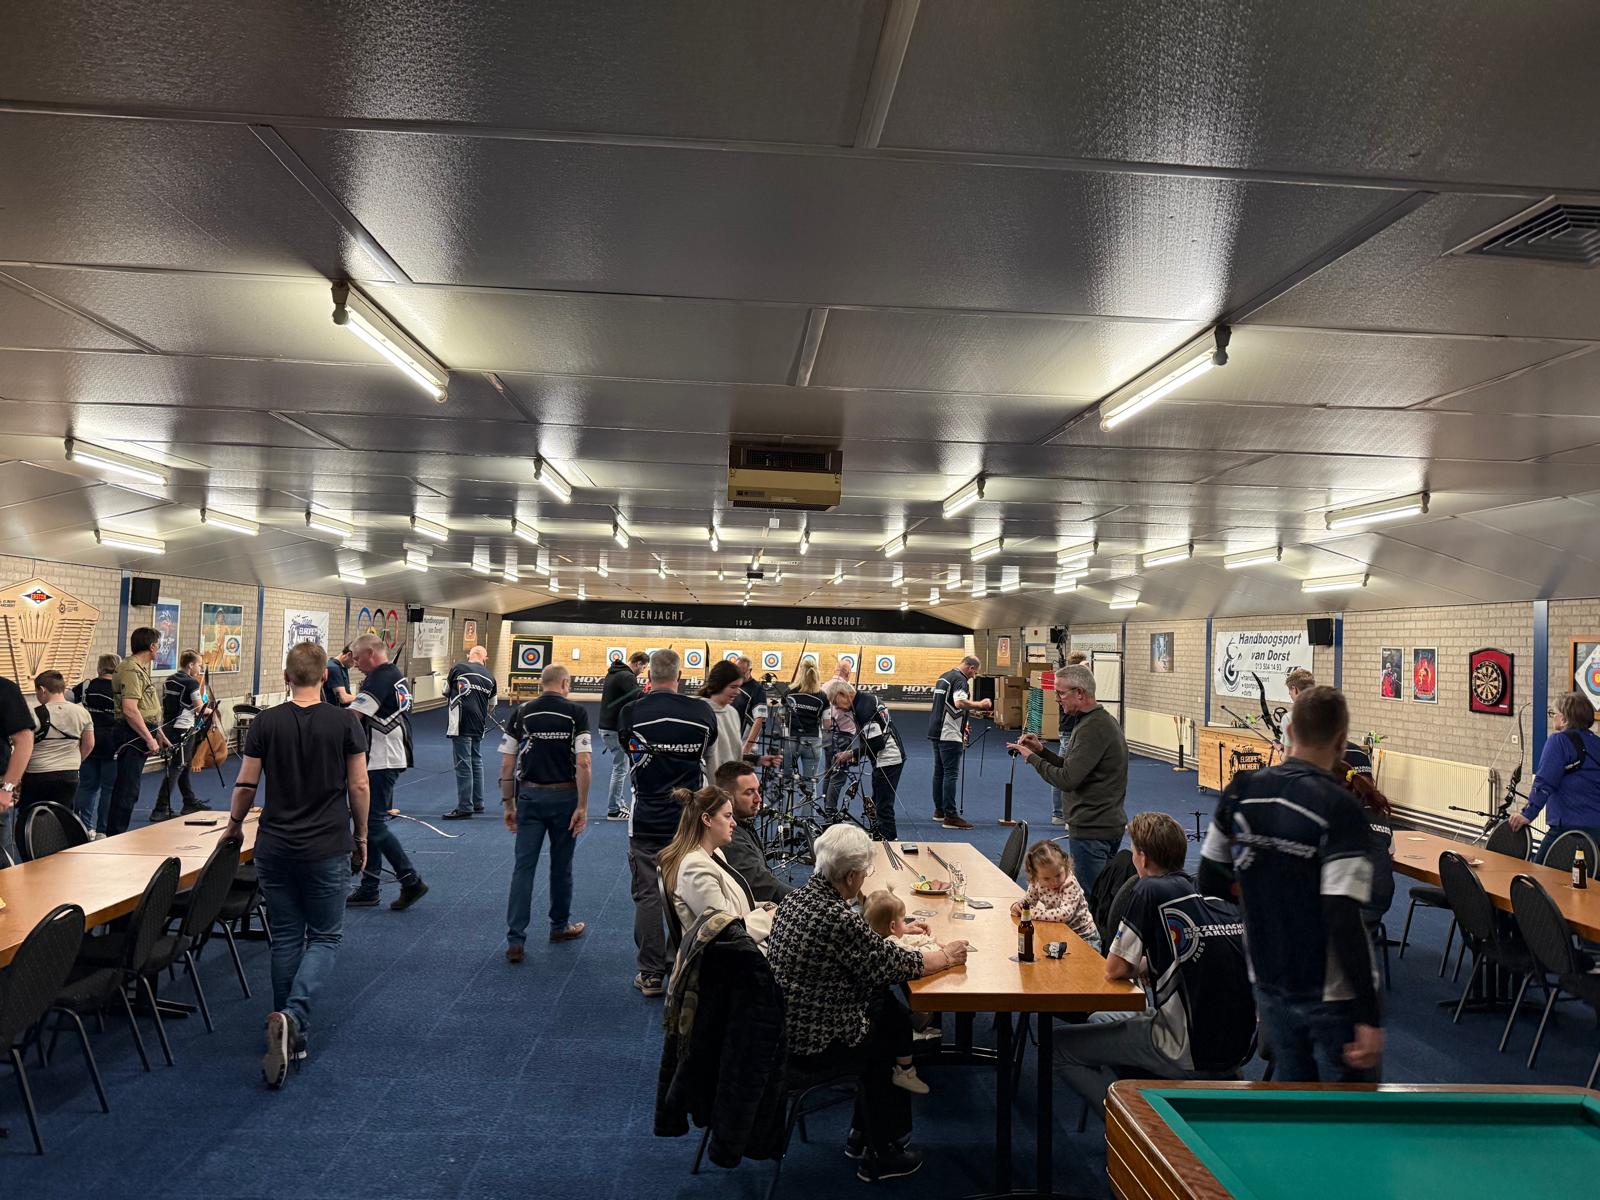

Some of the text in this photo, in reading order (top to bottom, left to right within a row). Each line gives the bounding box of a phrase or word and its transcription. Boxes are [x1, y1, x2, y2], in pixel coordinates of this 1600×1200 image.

[620, 609, 684, 621] ROZENJACHT
[806, 615, 862, 626] BAARSCHOT
[1239, 632, 1302, 647] Handboogsport
[1251, 650, 1291, 661] van Dorst
[1183, 923, 1244, 934] ROZENJACH
